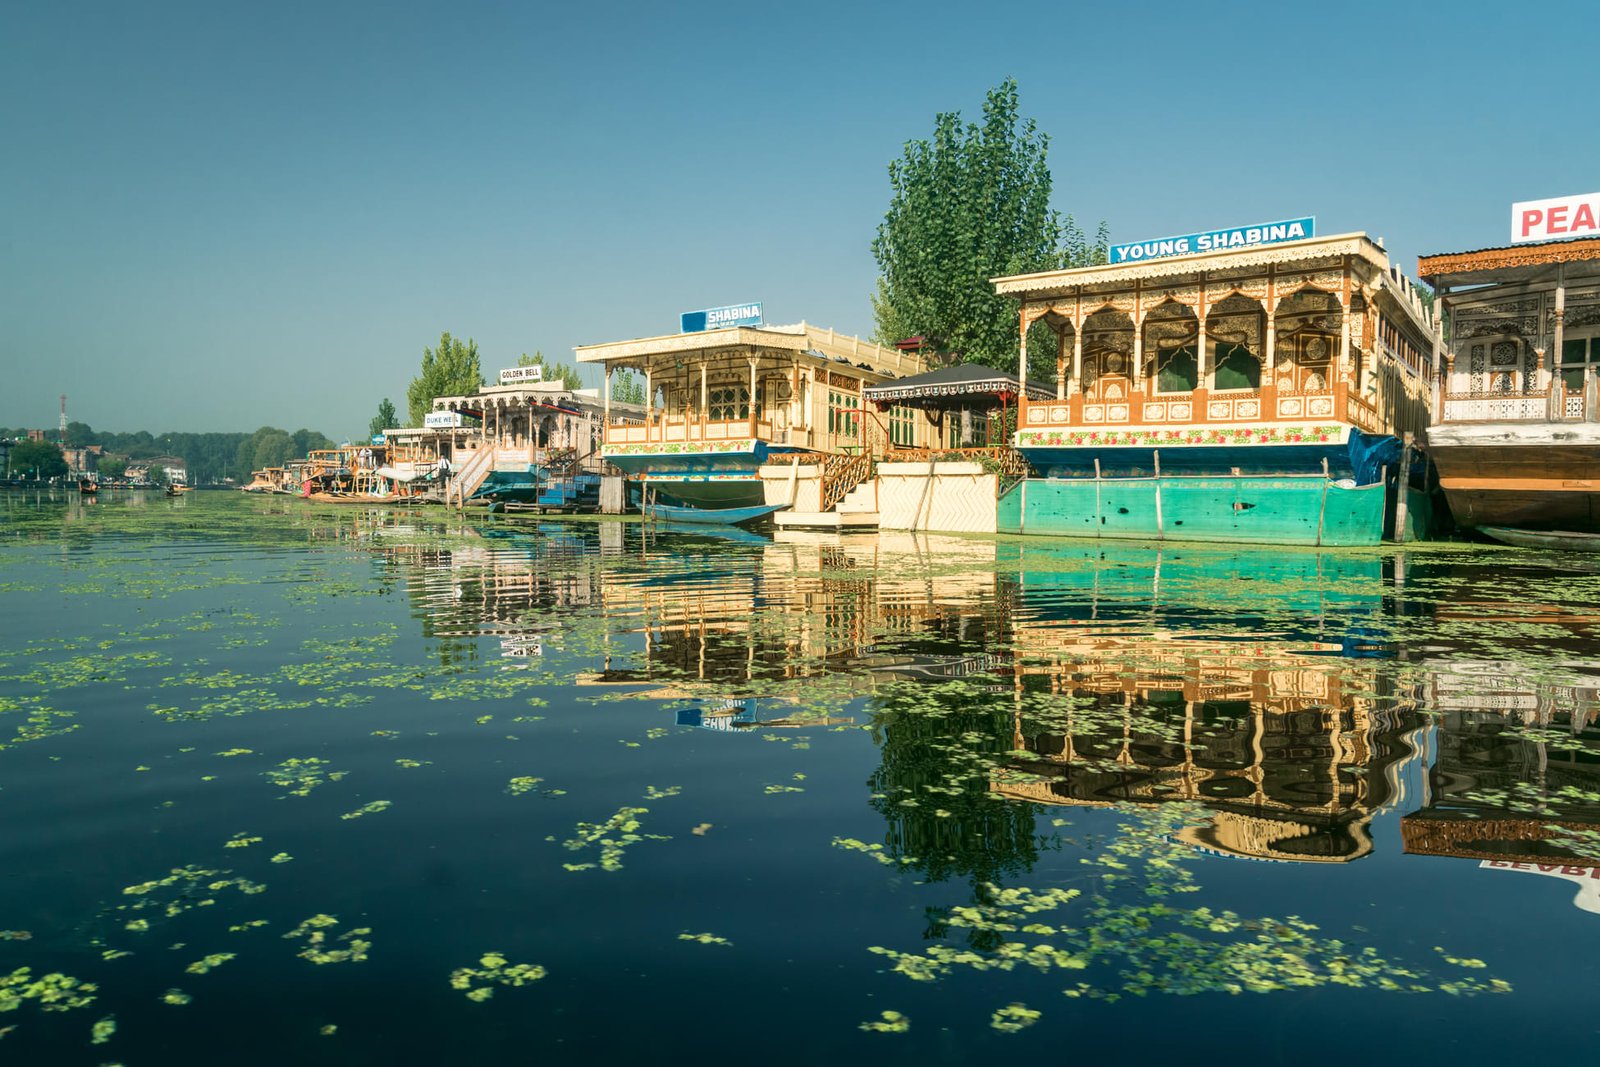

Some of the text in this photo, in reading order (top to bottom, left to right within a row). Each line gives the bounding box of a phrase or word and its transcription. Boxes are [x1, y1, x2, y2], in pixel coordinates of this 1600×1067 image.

[1521, 203, 1600, 237] PEA
[1116, 238, 1190, 260] YOUNG
[1197, 222, 1305, 250] SHABINA
[708, 305, 760, 323] SHABINA
[502, 368, 539, 378] GOLDEN BELL
[426, 416, 442, 424] DUKE
